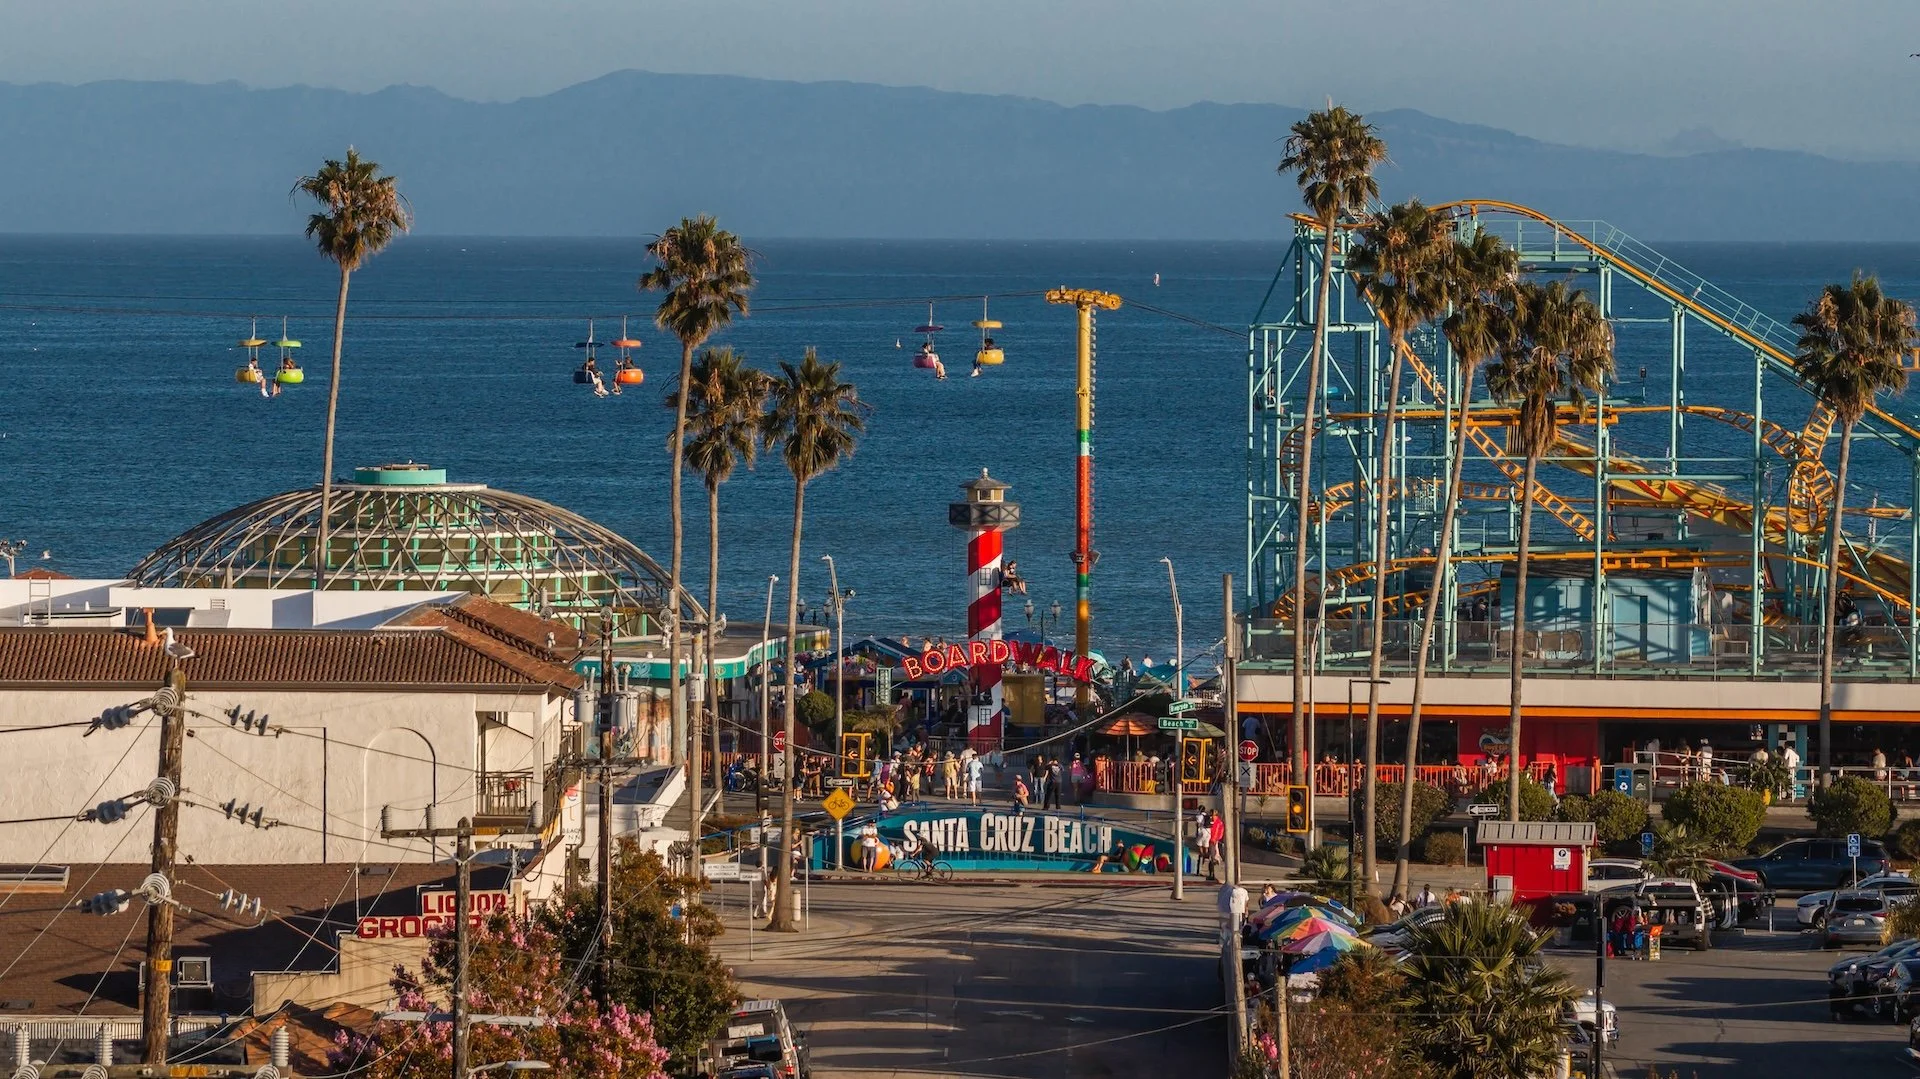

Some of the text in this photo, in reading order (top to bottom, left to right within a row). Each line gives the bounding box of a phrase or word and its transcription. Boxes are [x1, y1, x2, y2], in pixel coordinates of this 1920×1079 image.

[903, 640, 1096, 682] BOARDWALK
[1240, 746, 1257, 756] STOP
[903, 813, 1112, 853] SANTA CRUZ BEACH
